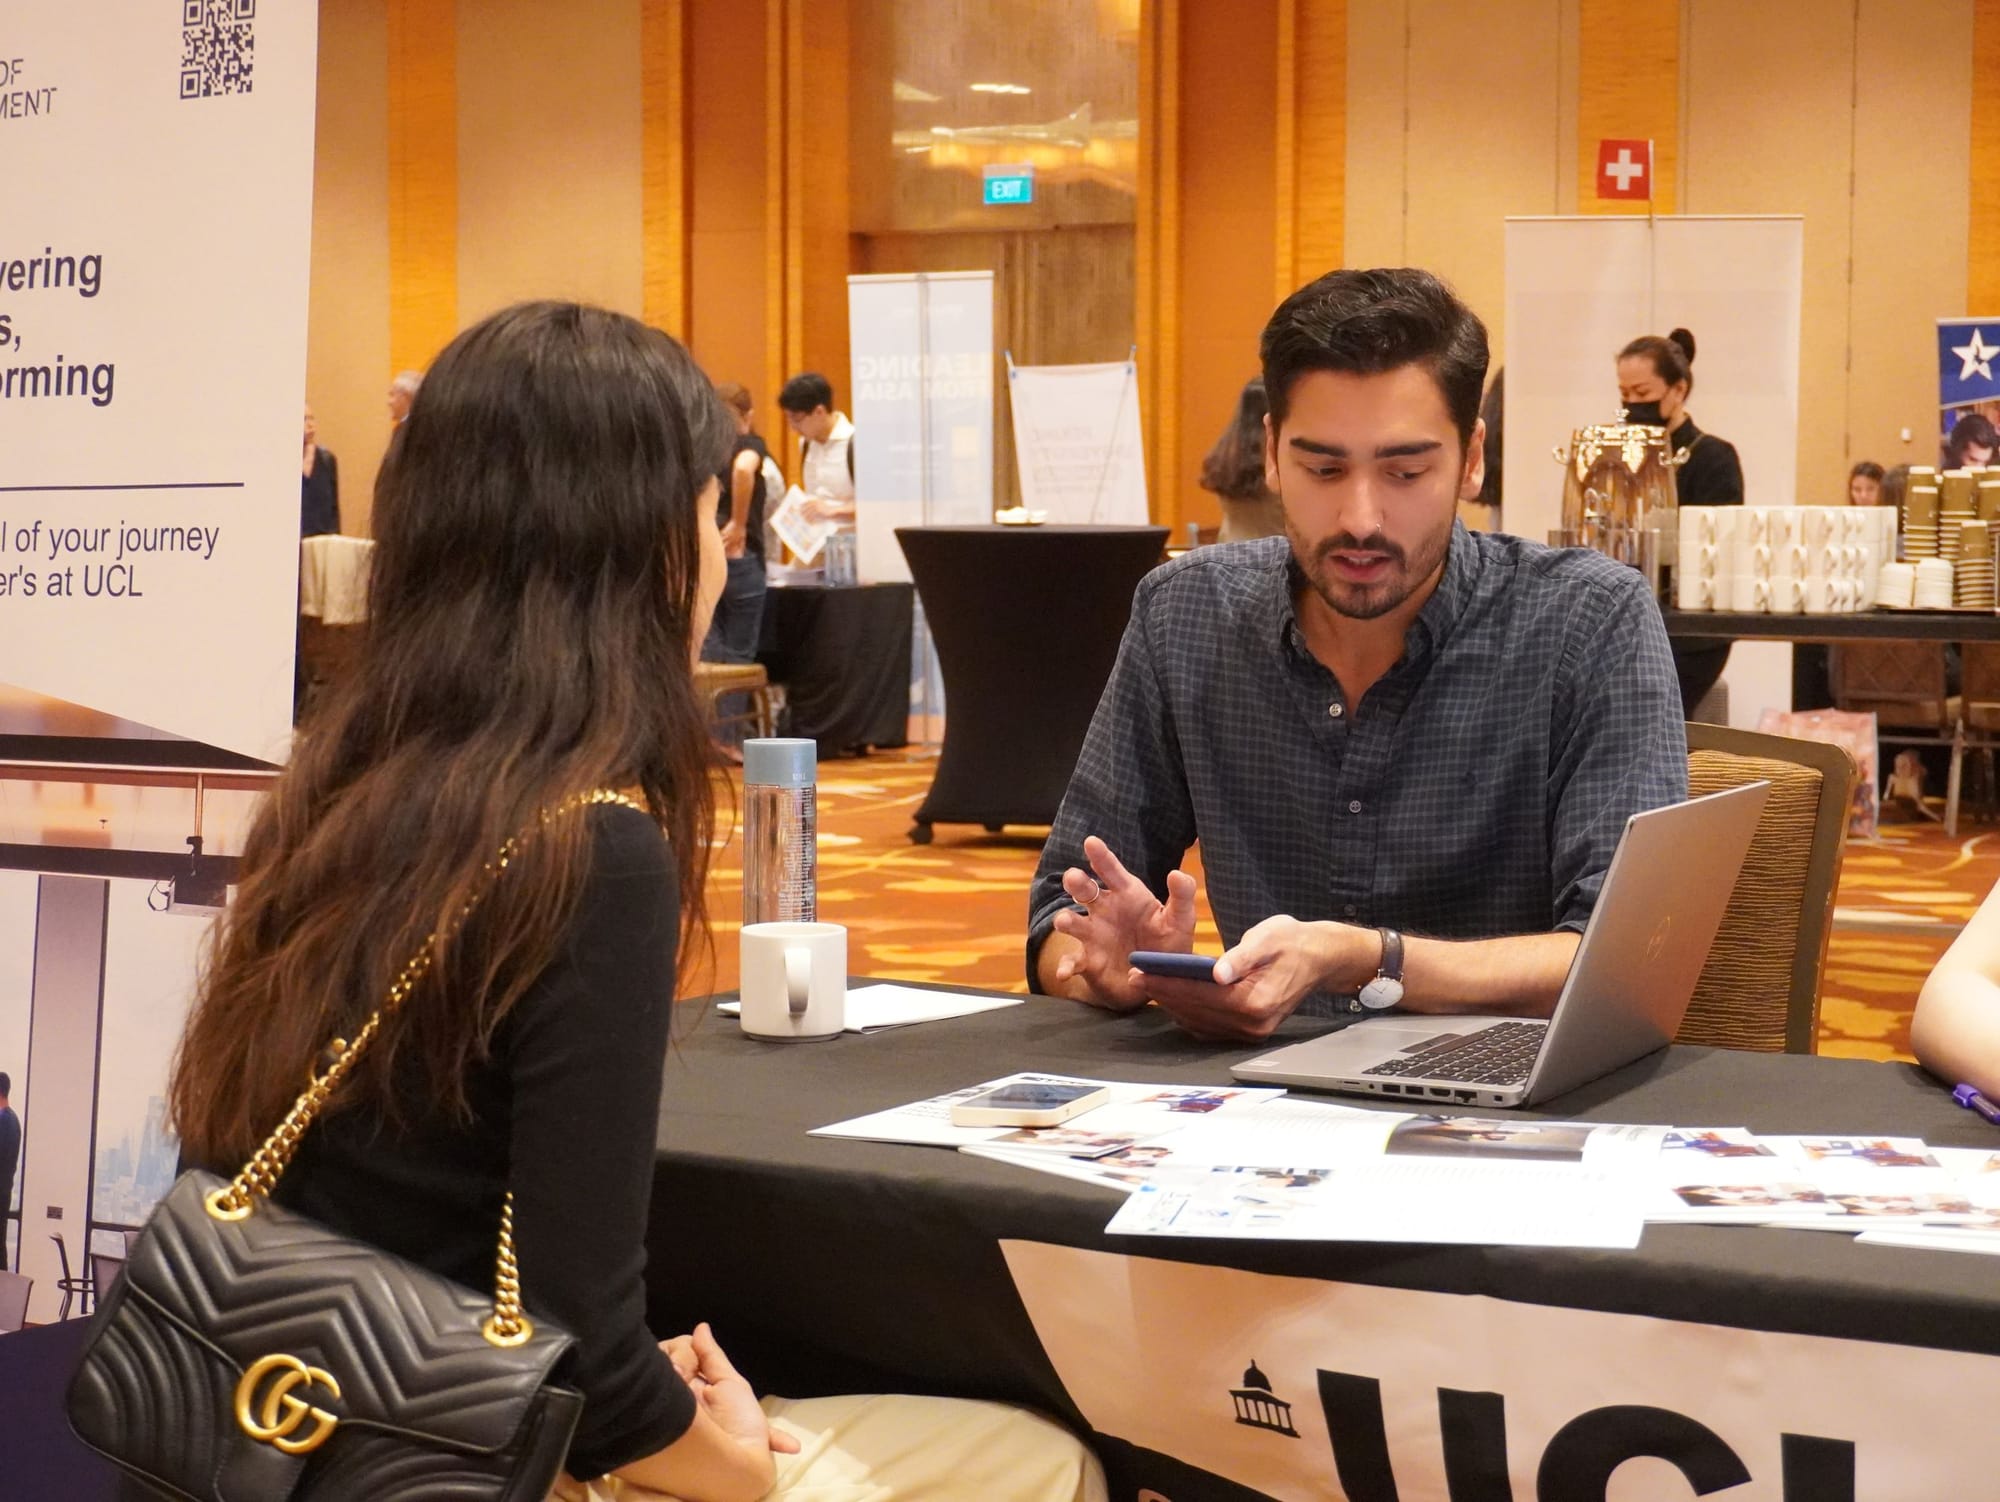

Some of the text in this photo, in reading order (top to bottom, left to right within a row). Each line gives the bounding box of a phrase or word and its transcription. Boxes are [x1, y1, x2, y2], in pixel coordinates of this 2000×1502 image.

[0, 246, 103, 298] ering
[0, 353, 115, 407] rming
[15, 519, 43, 552] of
[49, 527, 111, 561] your
[116, 519, 220, 561] journey
[46, 566, 73, 597] at
[84, 564, 143, 597] UCL
